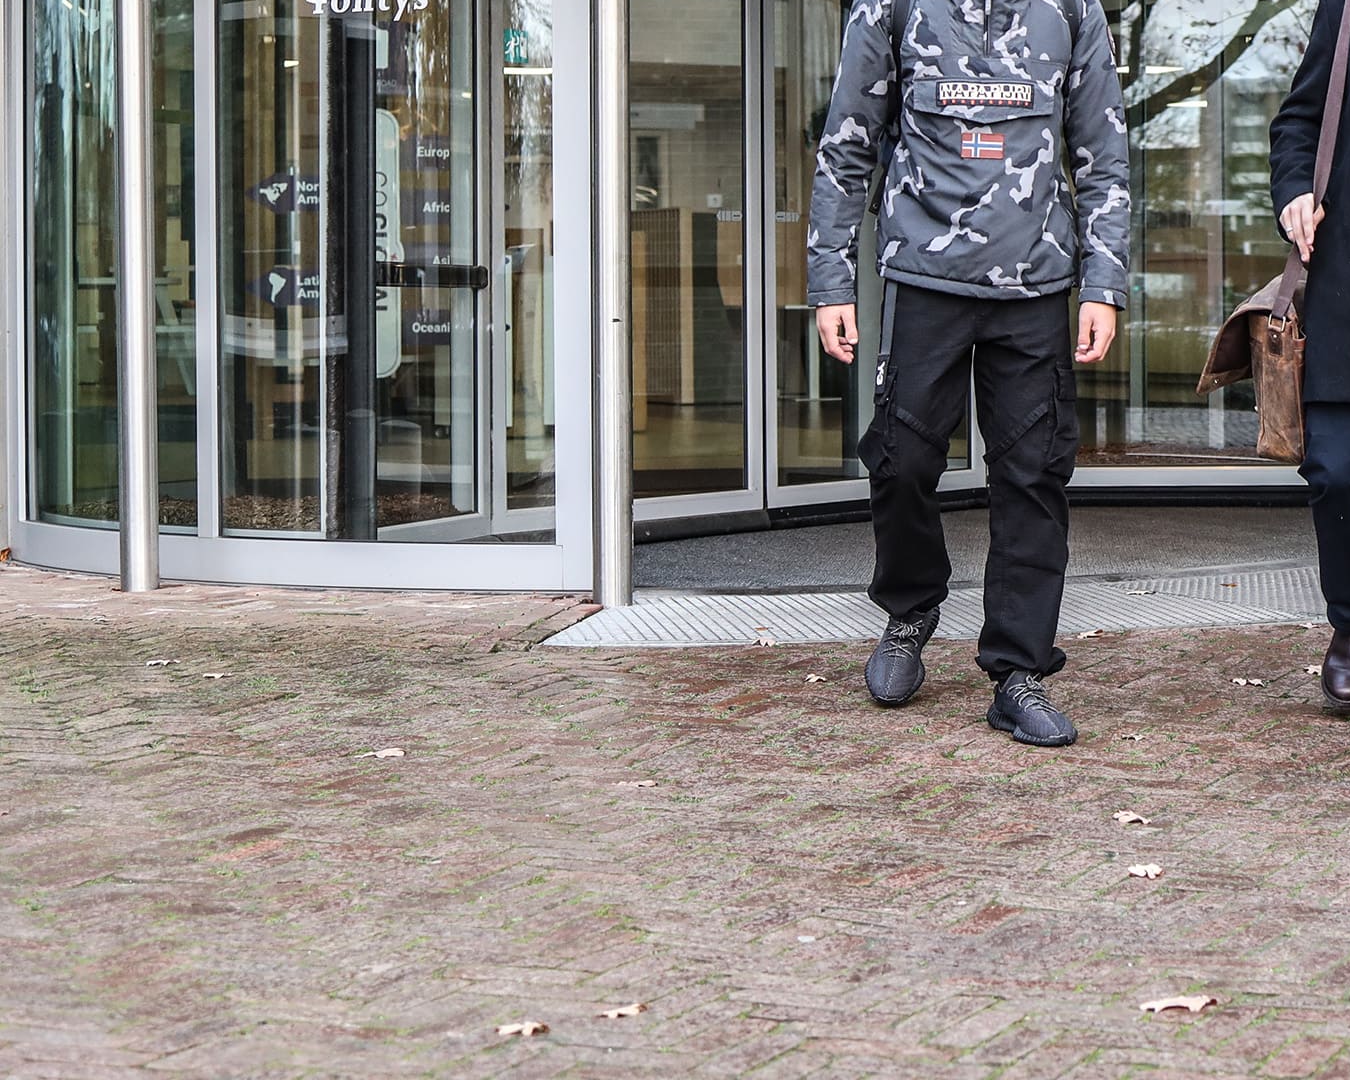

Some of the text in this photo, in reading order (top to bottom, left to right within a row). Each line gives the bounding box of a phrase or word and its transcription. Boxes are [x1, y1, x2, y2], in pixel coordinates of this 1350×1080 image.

[940, 83, 1031, 100] NAPAPIJRI
[297, 195, 320, 204] Am
[297, 288, 320, 298] Am
